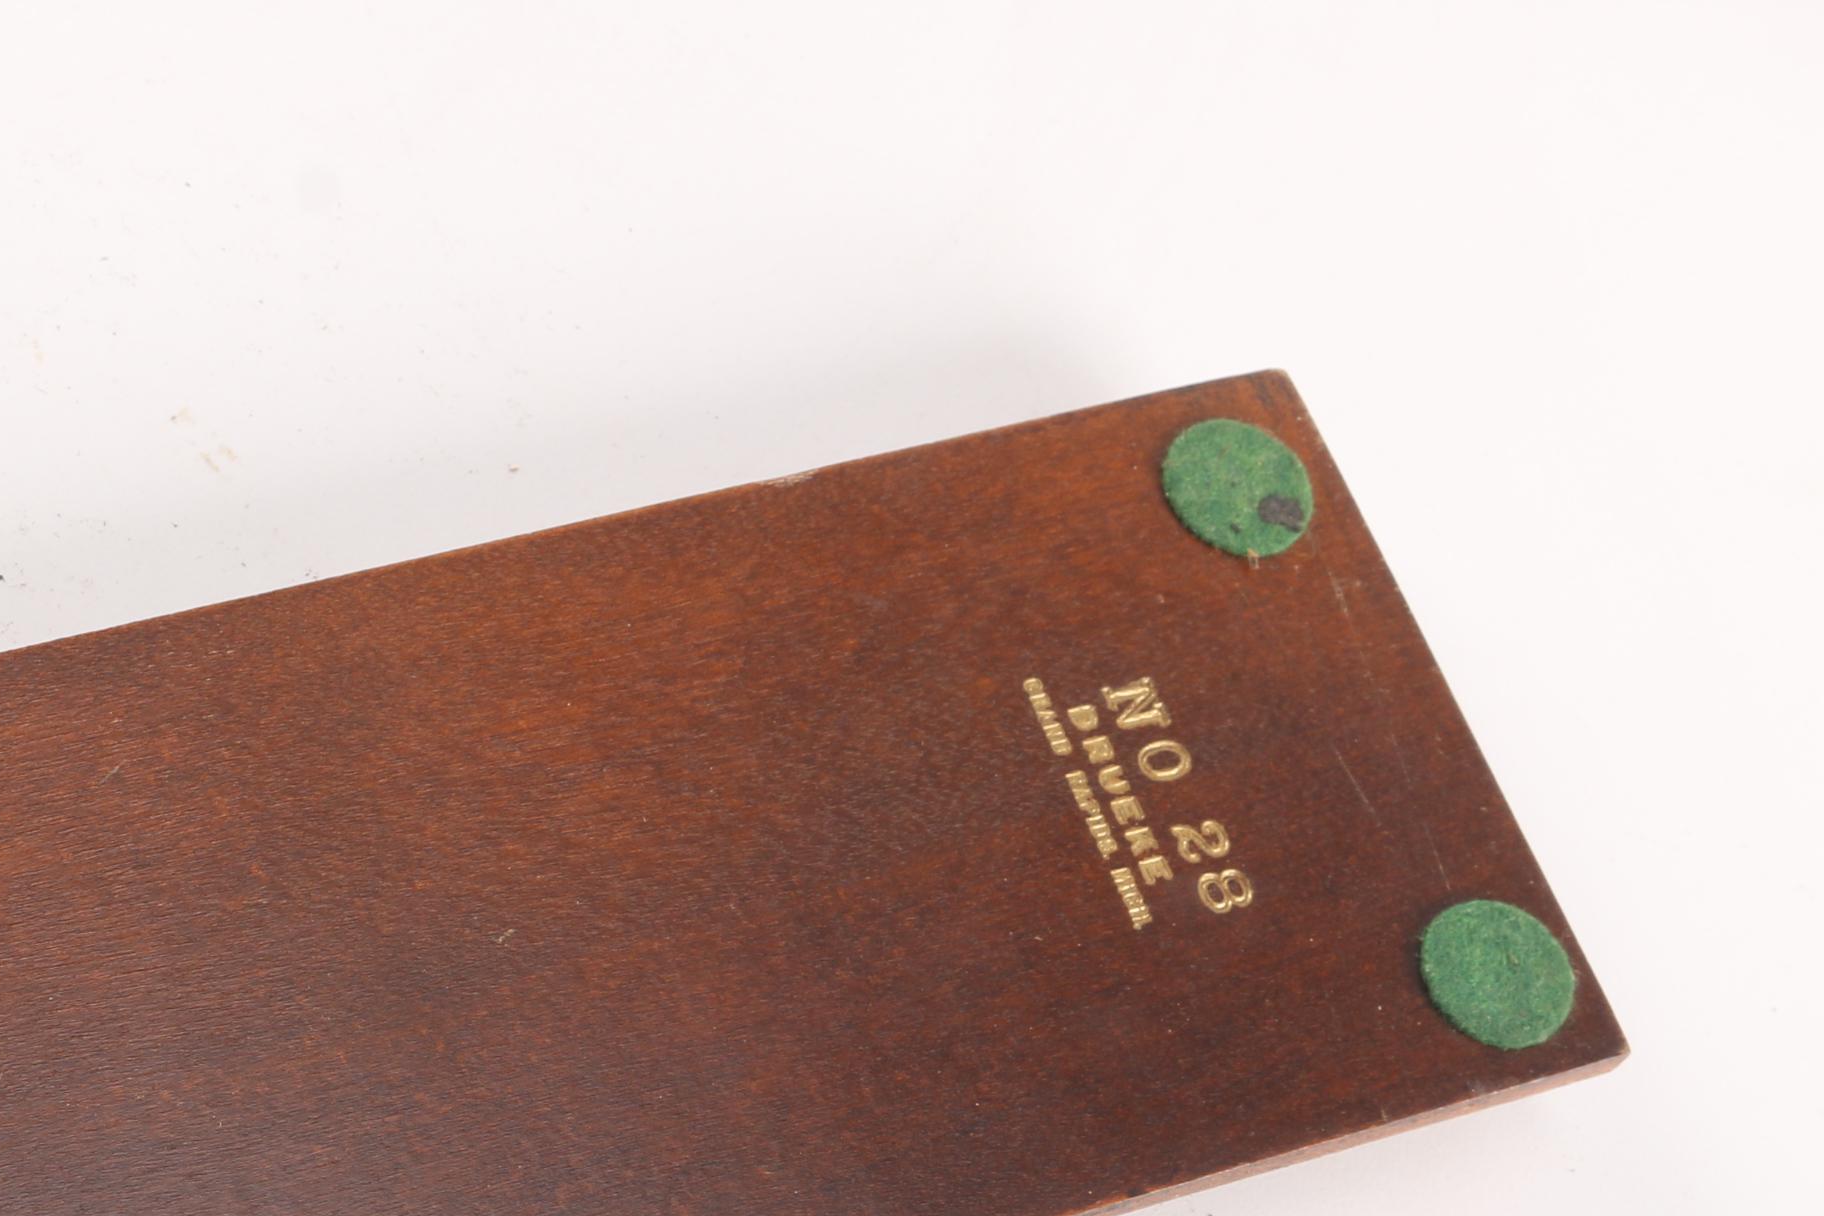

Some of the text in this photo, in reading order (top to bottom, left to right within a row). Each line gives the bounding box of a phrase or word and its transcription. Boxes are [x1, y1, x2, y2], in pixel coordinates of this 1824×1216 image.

[1023, 677, 1072, 756] GRAND
[1067, 704, 1174, 885] DRUEKE
[1101, 677, 1254, 914] NO 28
